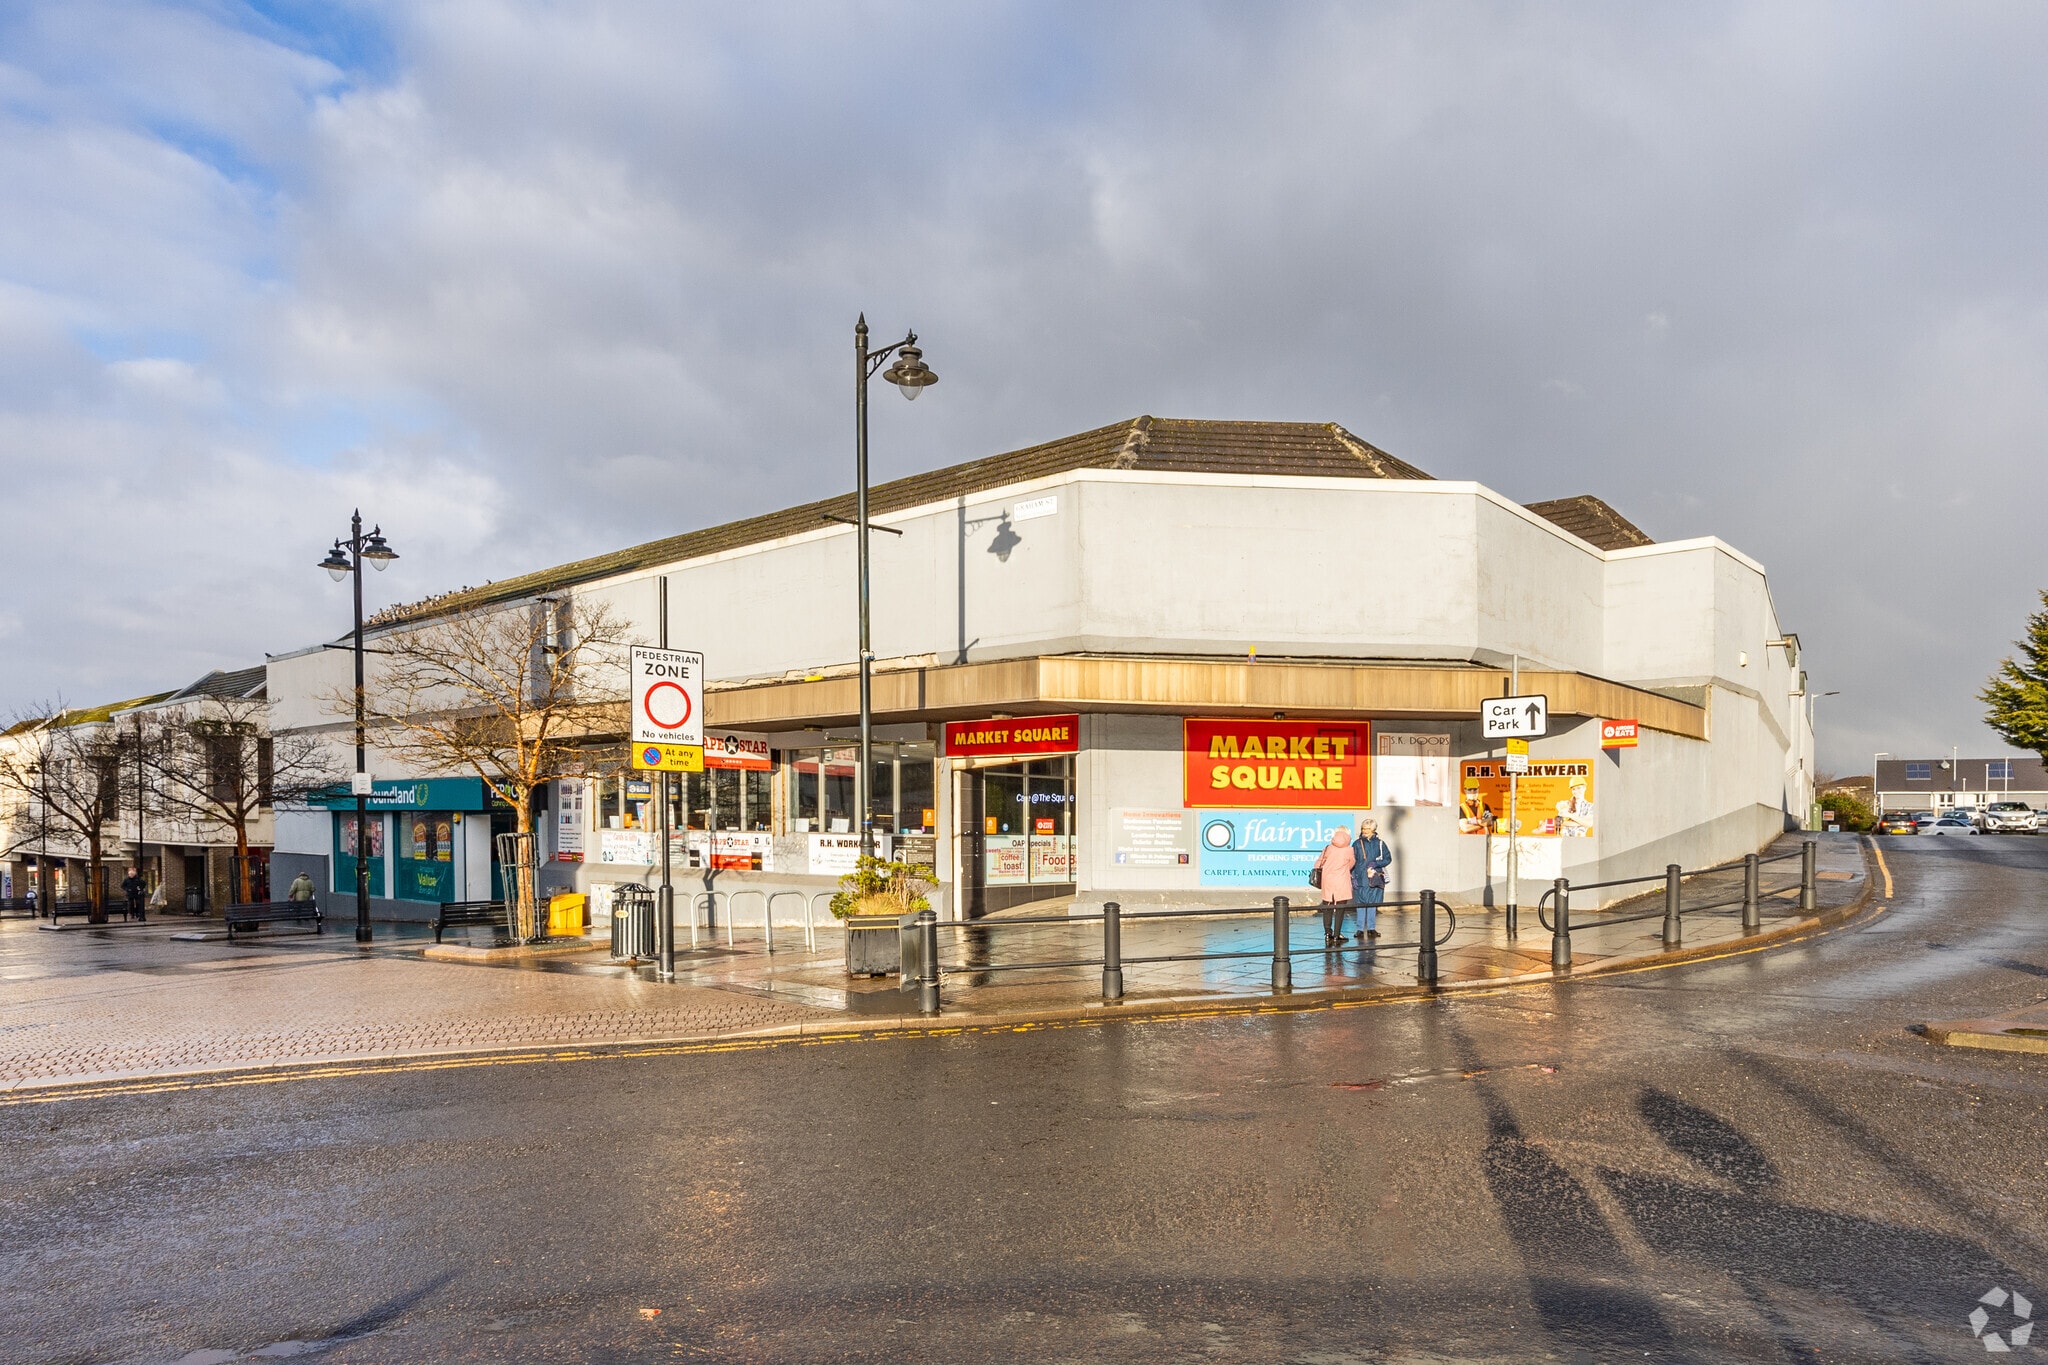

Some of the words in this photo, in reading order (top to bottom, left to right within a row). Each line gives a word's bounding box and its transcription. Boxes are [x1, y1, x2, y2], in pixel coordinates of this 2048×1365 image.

[635, 650, 699, 664] PEDESTRIAN
[645, 663, 689, 679] ZONE
[1492, 705, 1517, 716] Car
[1488, 718, 1520, 731] Park
[642, 730, 656, 739] No
[658, 731, 695, 741] vehicles
[954, 730, 1010, 746] MARKET
[1013, 726, 1069, 743] SQUARE
[1615, 729, 1635, 737] EATS
[704, 737, 725, 751] APE
[739, 739, 769, 755] STAR
[1390, 736, 1406, 745] S.K.
[1409, 736, 1450, 746] DOORS
[1208, 735, 1350, 761] MARKET
[665, 749, 675, 757] At
[679, 750, 694, 760] any
[670, 758, 689, 768] time
[1466, 766, 1495, 777] R.H.
[1500, 764, 1588, 777] WRKWEAR
[1211, 765, 1344, 791] SQUARE
[1237, 818, 1353, 850] flairpla
[734, 838, 749, 846] STAR
[819, 839, 835, 848] R.H.
[836, 839, 881, 849] WORKR
[1030, 839, 1051, 848] pecials
[1001, 853, 1020, 861] coffee
[1042, 854, 1066, 866] Food
[1247, 854, 1290, 862] FLOORING
[1004, 862, 1022, 870] toast
[1204, 869, 1240, 877] CARPET,
[1242, 869, 1289, 877] LAMINATE,
